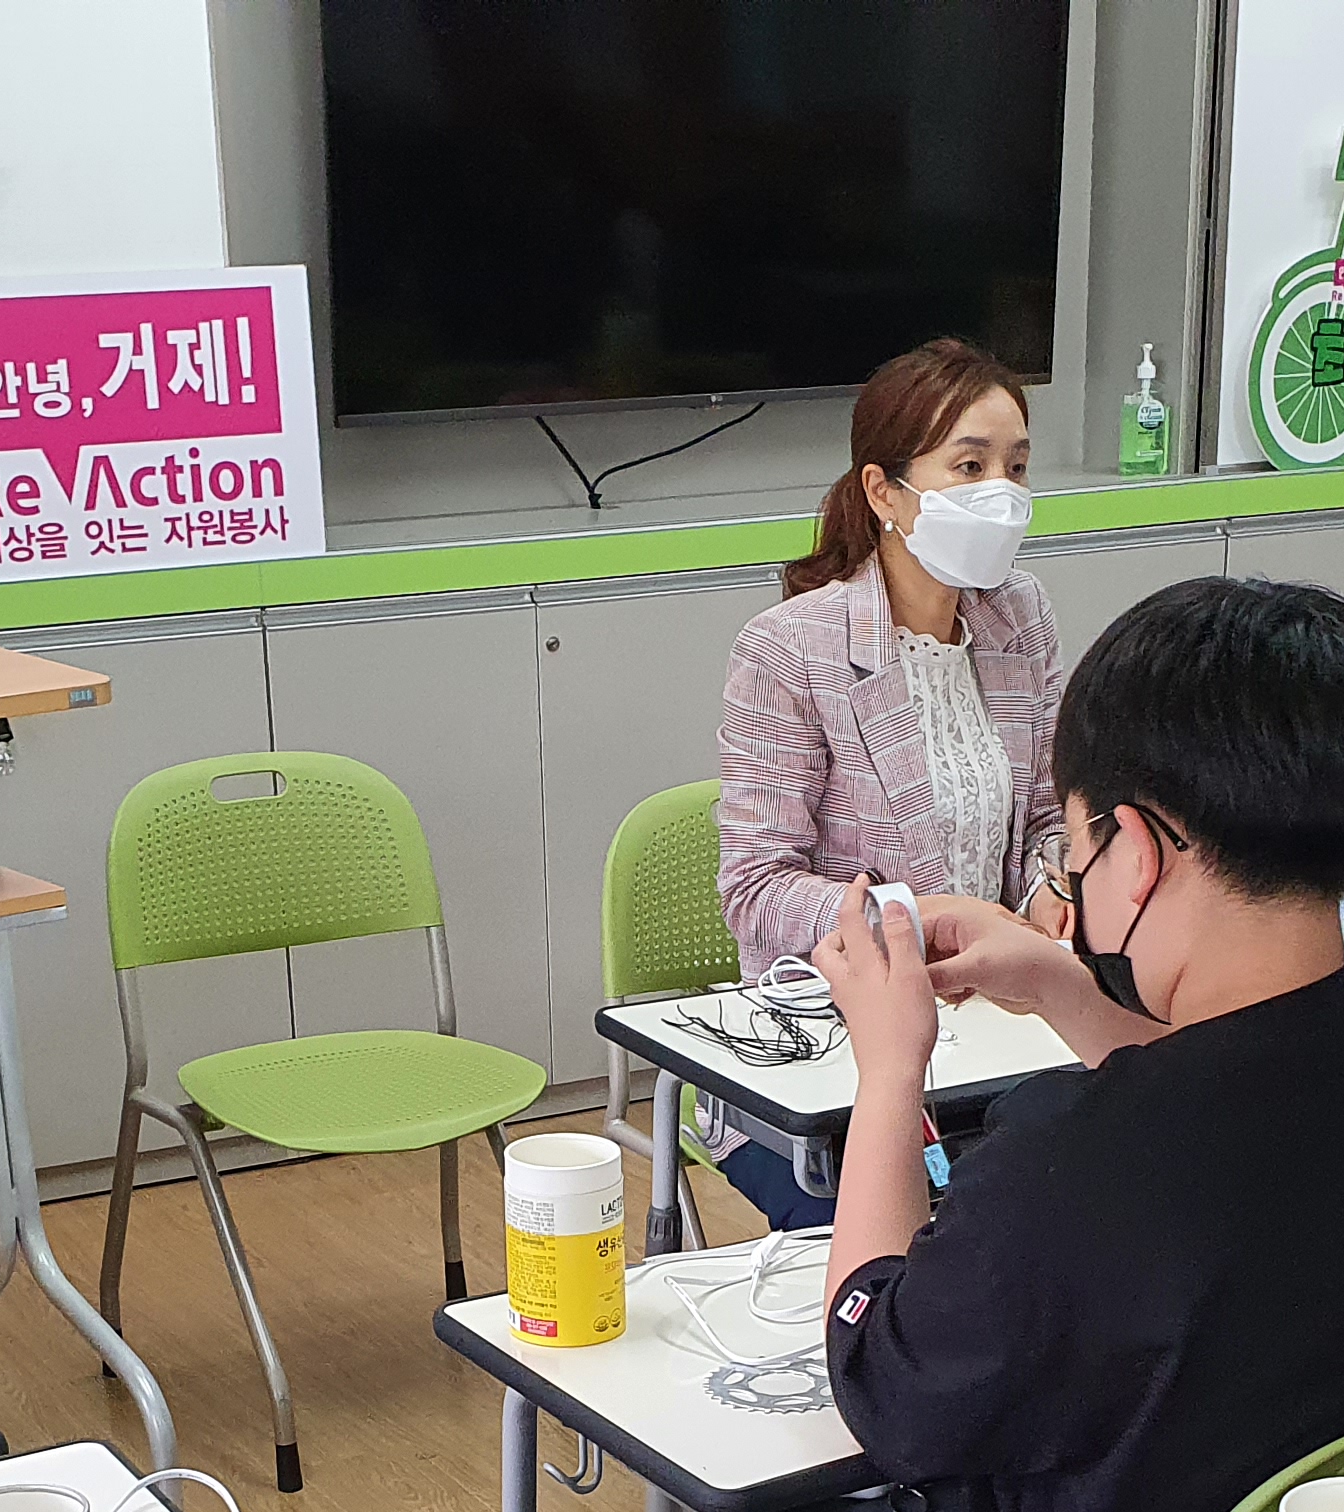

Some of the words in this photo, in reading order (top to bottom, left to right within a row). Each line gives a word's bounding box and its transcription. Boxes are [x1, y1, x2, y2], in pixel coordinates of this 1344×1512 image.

[98, 317, 257, 410] 거제!
[84, 516, 149, 556] 잇는
[163, 505, 290, 549] 자원봉사
